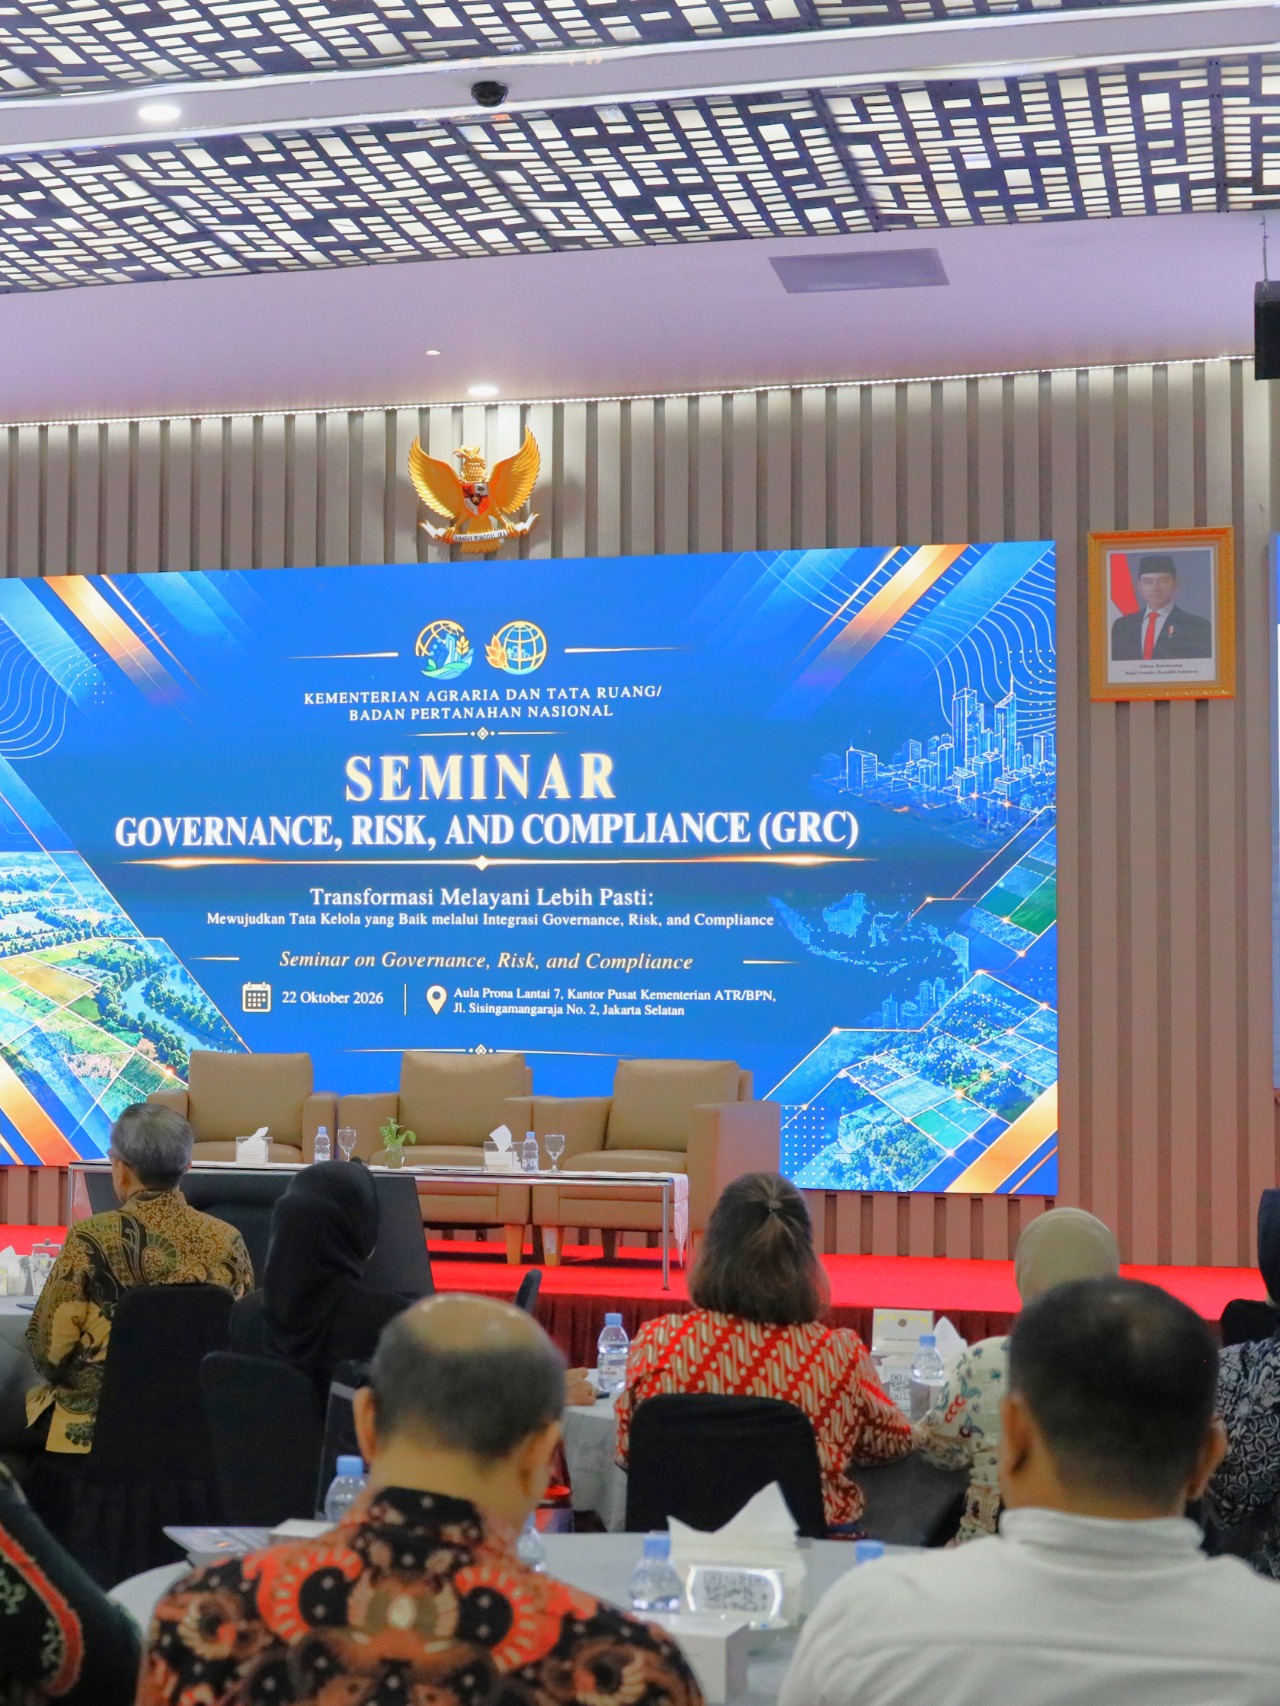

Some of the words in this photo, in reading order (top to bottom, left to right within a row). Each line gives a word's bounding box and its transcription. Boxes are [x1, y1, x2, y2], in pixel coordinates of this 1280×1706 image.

[304, 691, 419, 704] KEMENTERIAN
[426, 689, 499, 702] AGRARIA
[506, 688, 540, 700] DAN
[546, 687, 590, 699] TATA
[597, 685, 661, 698] RUANG/
[349, 708, 405, 721] BADAN
[411, 706, 521, 719] PERTANAHAN
[528, 704, 613, 717] NASIONAL
[345, 752, 616, 802] SEMINAR
[115, 815, 342, 851] GOVERNANCE,
[351, 814, 436, 850] RISK,
[444, 814, 514, 844] AND
[521, 812, 750, 844] COMPLIANCE
[759, 810, 859, 847] (GRC)
[309, 888, 433, 905] Transformasi
[440, 888, 529, 910] Melayani
[537, 888, 592, 905] Lebih
[600, 888, 653, 906] Pasti:
[207, 912, 285, 927] Mewujudkan
[289, 912, 316, 924] Tata
[320, 912, 360, 924] Kelola
[365, 916, 394, 928] yang
[399, 913, 428, 924] Baik
[432, 913, 478, 925] melalui
[483, 913, 538, 928] Integrasi
[542, 913, 624, 926] Governance,
[629, 913, 662, 926] Risk,
[666, 913, 690, 925] and
[694, 913, 774, 929] Compliance
[280, 951, 349, 966] Seminar
[354, 956, 375, 966] on
[382, 951, 489, 969] Governance,
[498, 952, 538, 969] Risk,
[546, 952, 579, 968] and
[586, 953, 692, 973] Compliance
[282, 991, 297, 1003] 22
[300, 991, 350, 1003] Oktober
[353, 991, 384, 1004] 2026
[454, 987, 479, 998] Aula
[482, 987, 513, 998] Prona
[516, 988, 550, 999] Lantai
[554, 988, 563, 1000] 7,
[567, 988, 605, 999] Kantor
[608, 989, 637, 1000] Pusat
[640, 989, 711, 1000] Kementerian
[714, 989, 776, 1002] ATR/BPN,
[453, 1002, 465, 1013] Jl.
[469, 1002, 563, 1017] Sisingamangaraja
[566, 1004, 586, 1014] No.
[589, 1004, 599, 1015] 2,
[602, 1004, 641, 1015] Jakarta
[644, 1004, 684, 1015] Selatan
